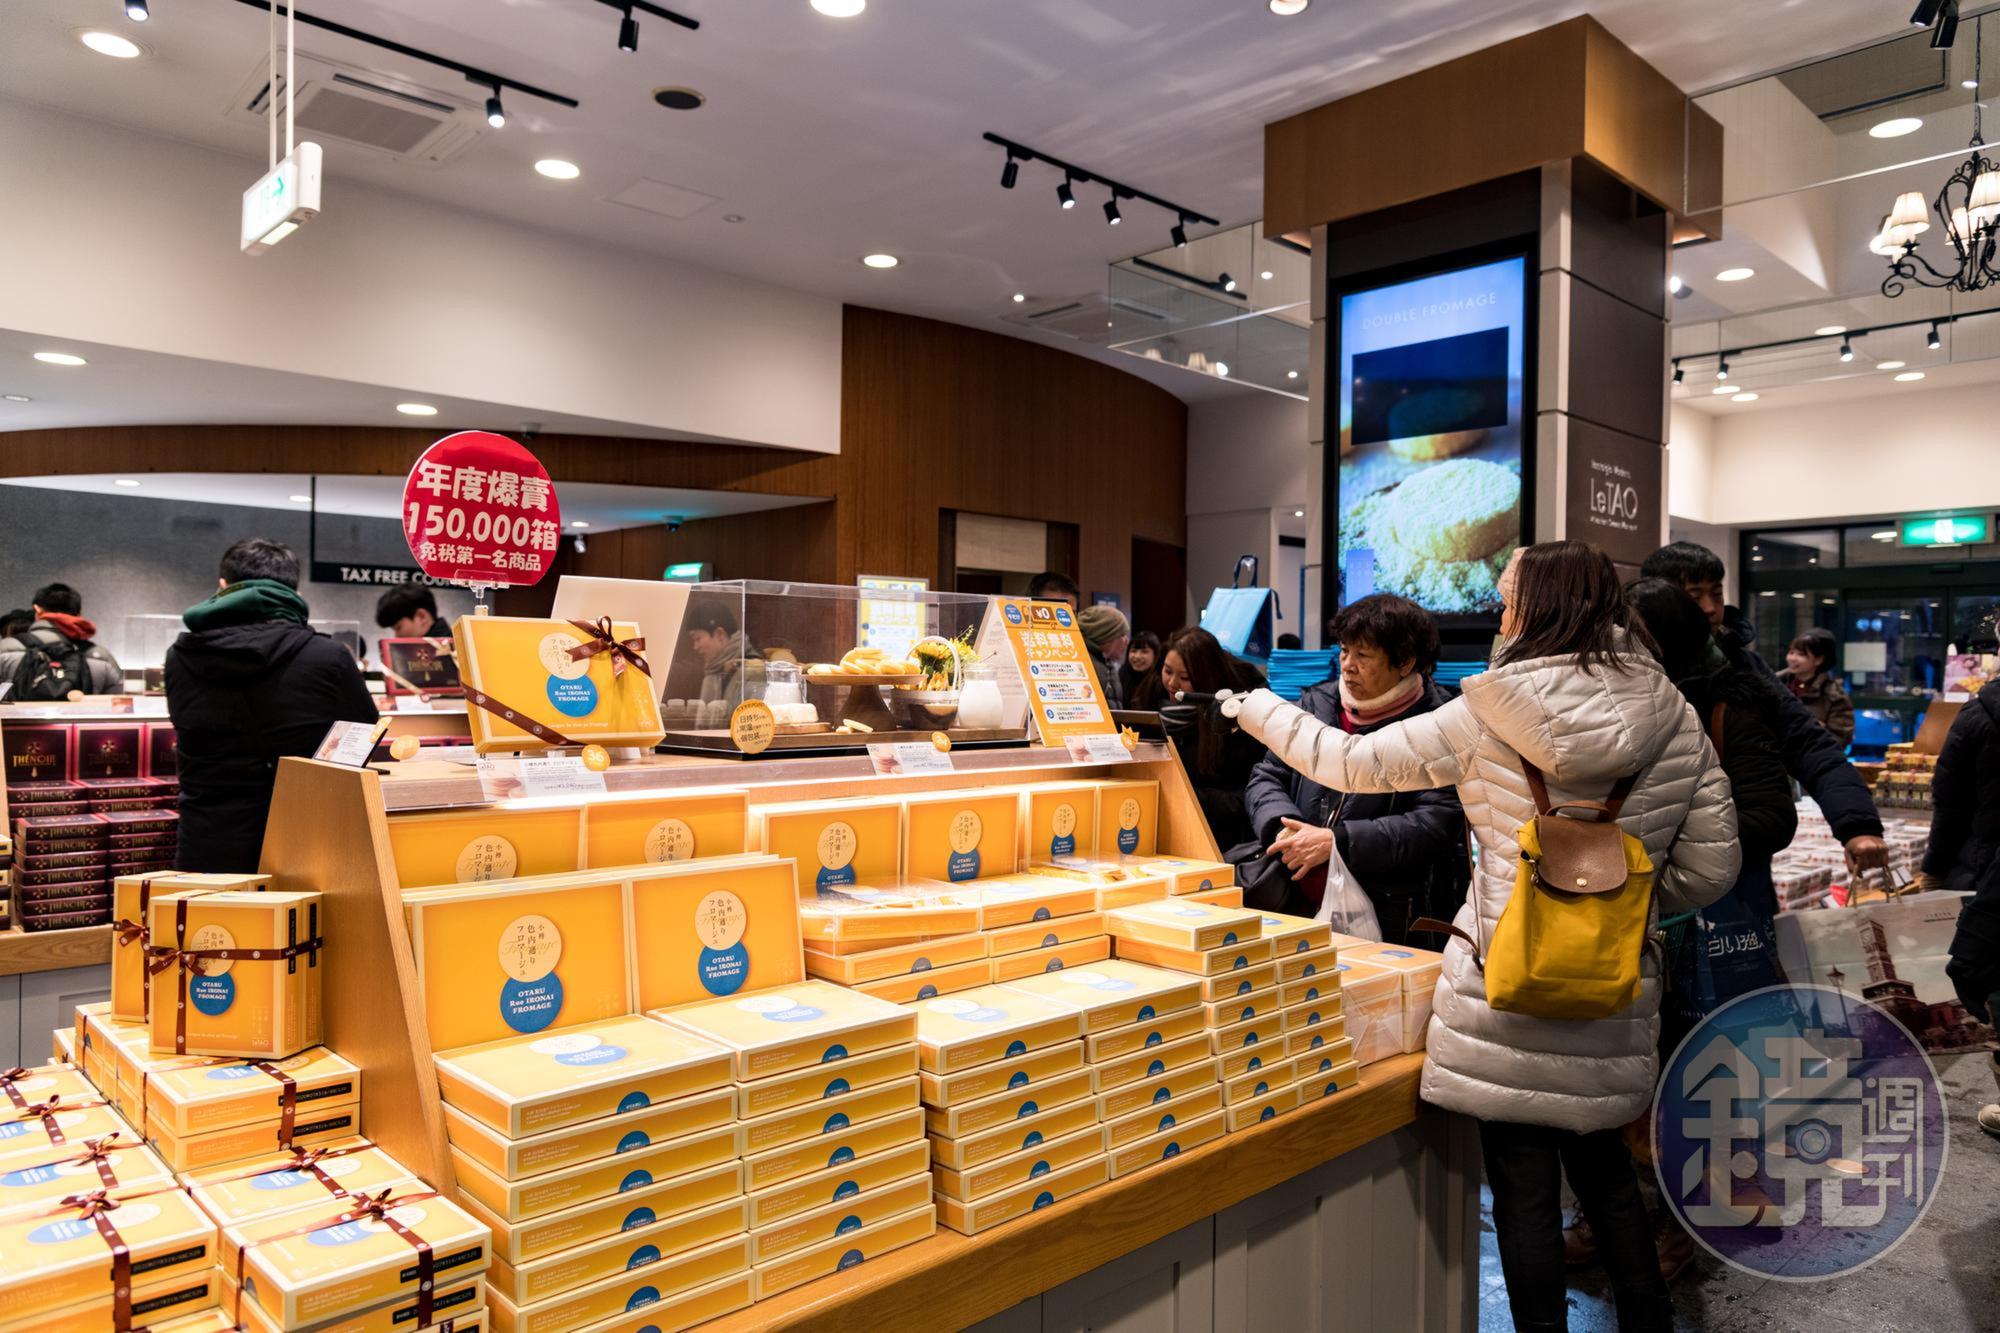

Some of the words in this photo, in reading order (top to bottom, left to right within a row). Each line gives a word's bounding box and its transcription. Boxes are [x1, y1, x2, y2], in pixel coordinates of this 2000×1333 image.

[1362, 307, 1417, 329] DOUBLE
[1422, 292, 1496, 317] FROMAGE
[416, 459, 551, 512] 年度爆賣
[1591, 478, 1638, 519] LeTAO
[408, 502, 558, 551] 150,000箱
[341, 567, 372, 582] TAX
[374, 570, 408, 584] FREE
[588, 750, 604, 763] 36
[712, 955, 735, 964] OTARU
[708, 968, 740, 979] FROMAGE
[518, 987, 546, 998] OTARU
[526, 994, 555, 1004] IRONAI
[513, 1002, 552, 1014] FROMAGE
